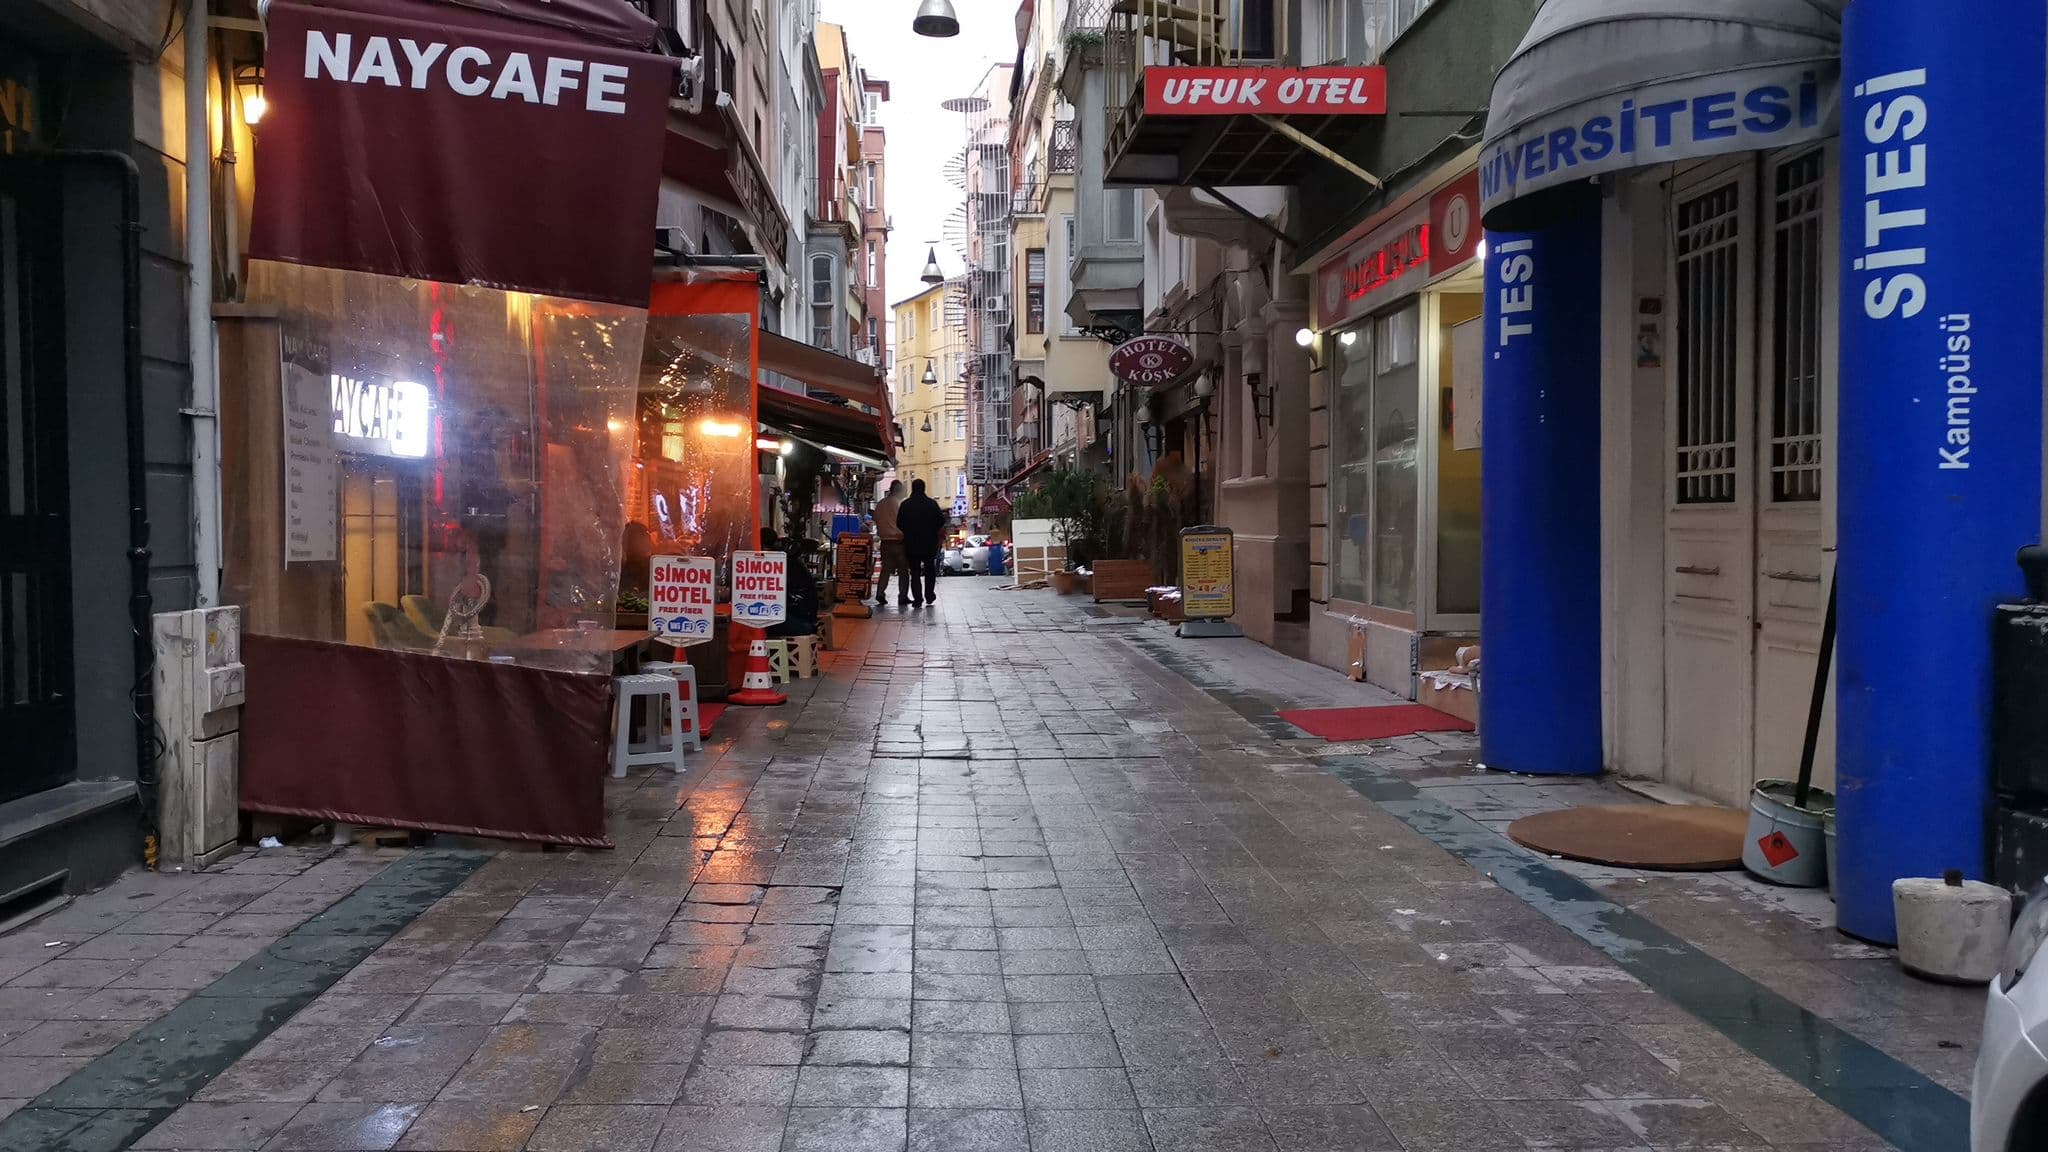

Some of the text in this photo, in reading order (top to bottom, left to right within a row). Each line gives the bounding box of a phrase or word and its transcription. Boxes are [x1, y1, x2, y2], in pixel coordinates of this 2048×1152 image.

[304, 30, 629, 114] NAYCAFE
[1162, 77, 1369, 106] UFUK OTEL
[1854, 67, 1927, 319] SİTESİ
[1122, 339, 1178, 357] HOTEL
[1128, 367, 1177, 384] KÖŞK
[1938, 313, 1978, 471] Kampüsü
[653, 563, 712, 584] SİMON
[735, 557, 784, 575] SİMON
[735, 576, 784, 591] HOTEL
[653, 586, 712, 604] HOTEL
[658, 606, 678, 614] FREE
